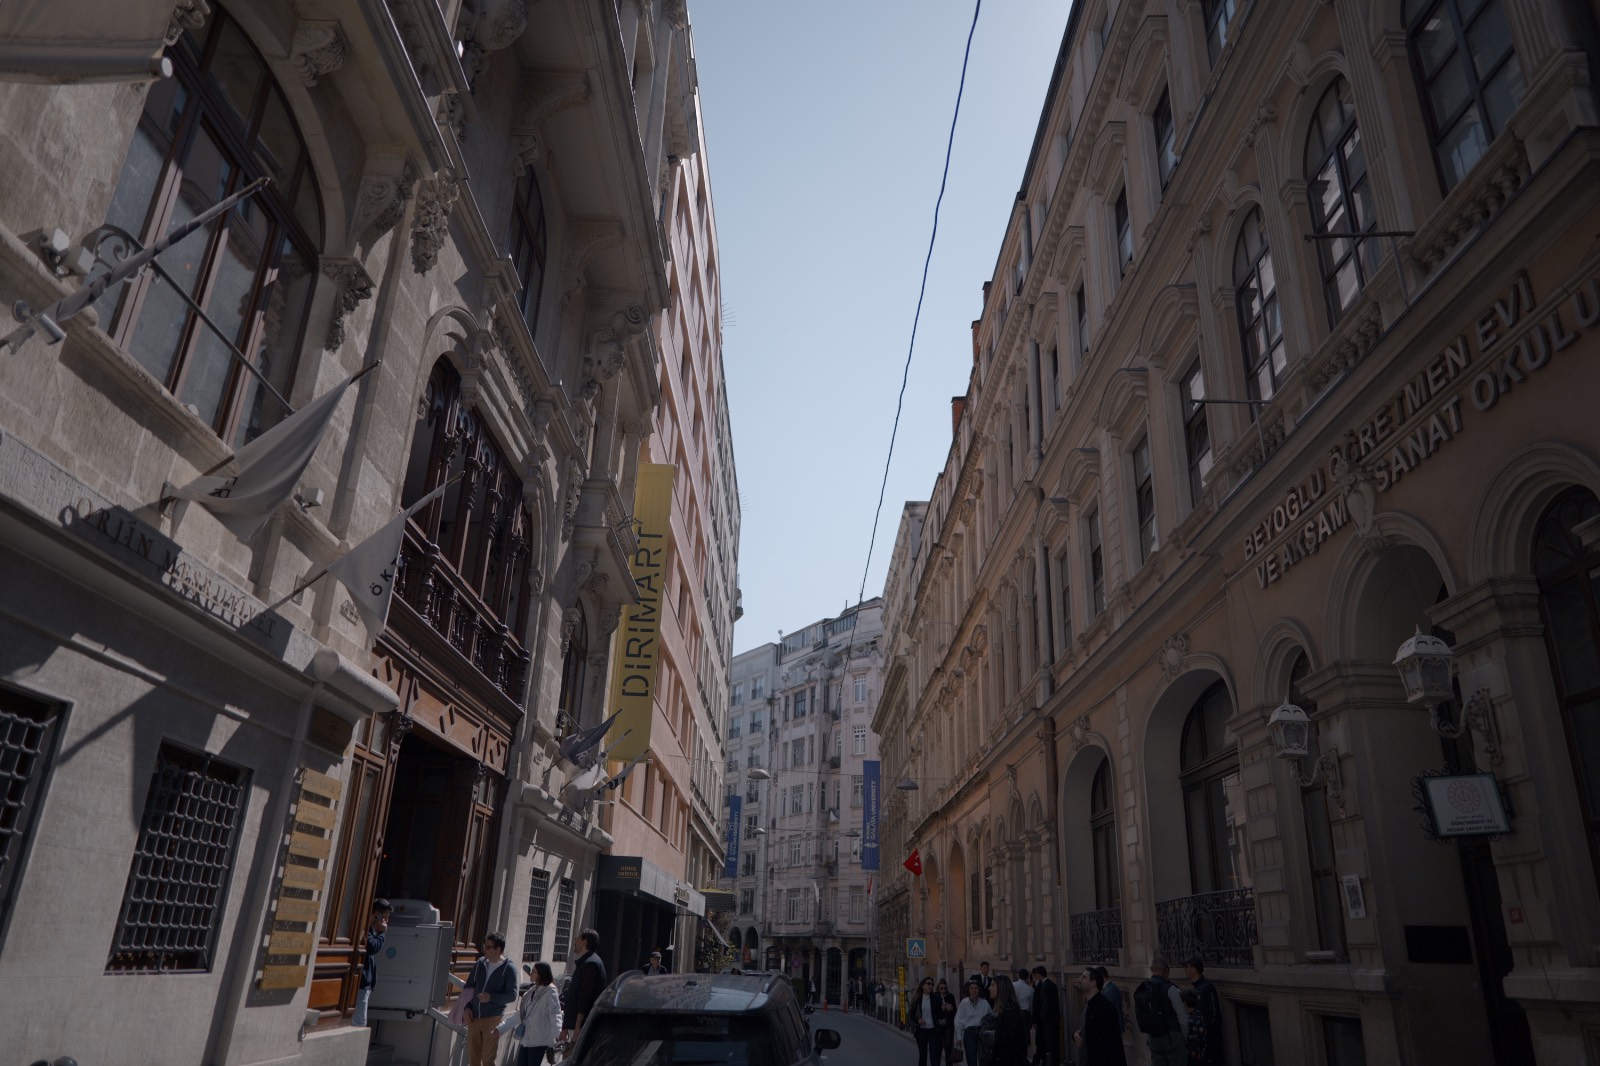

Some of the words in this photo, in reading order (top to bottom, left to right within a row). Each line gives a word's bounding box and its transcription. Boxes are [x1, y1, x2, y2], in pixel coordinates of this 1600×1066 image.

[1244, 467, 1325, 561] BEYOĞLU
[1475, 268, 1535, 352] EVİ
[1255, 552, 1281, 589] VE
[1281, 494, 1351, 573] AKŞAM
[1373, 394, 1463, 492] SANAT
[1470, 278, 1600, 411] OKULU
